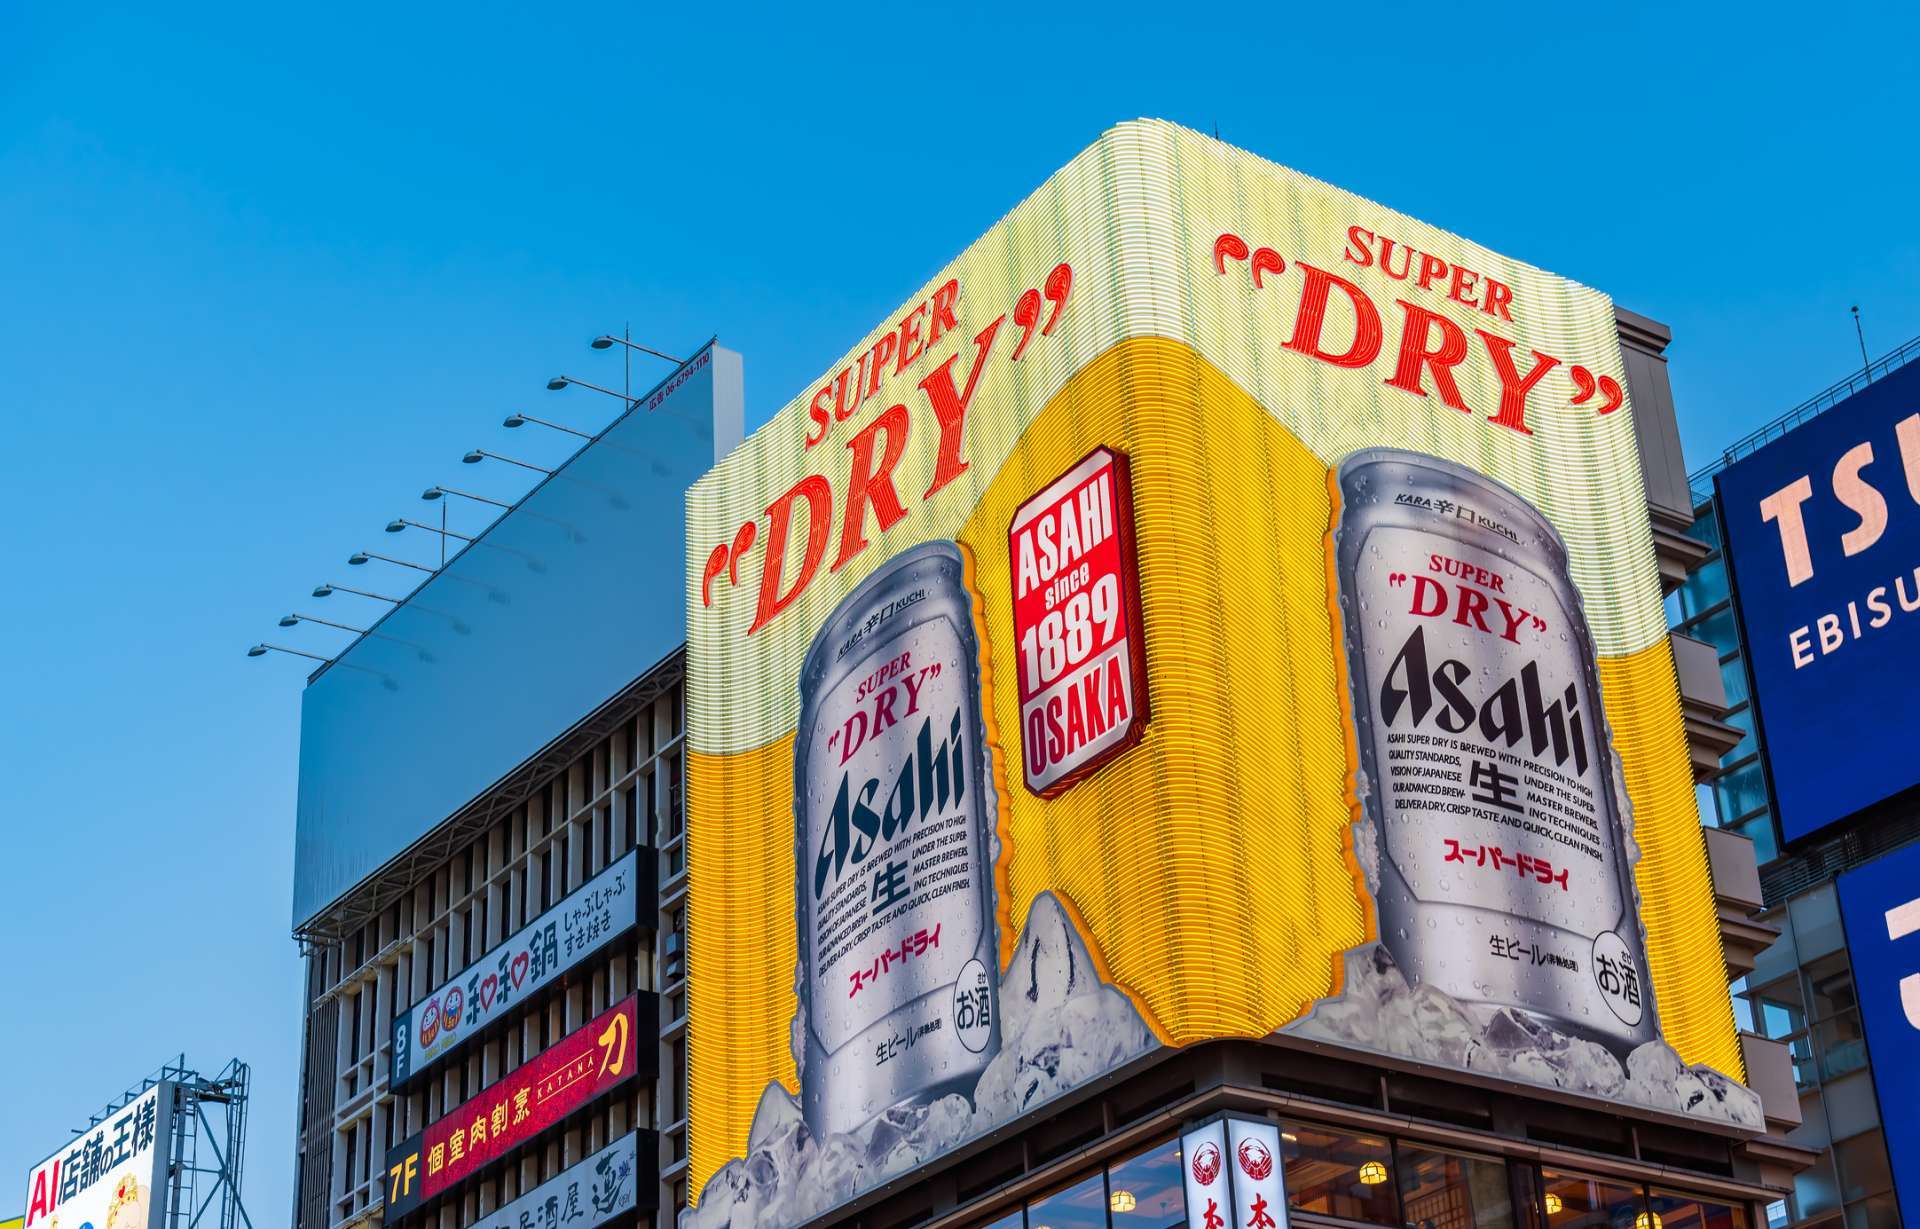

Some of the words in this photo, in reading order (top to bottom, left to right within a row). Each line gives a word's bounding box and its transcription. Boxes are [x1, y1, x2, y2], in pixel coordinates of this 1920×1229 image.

[1344, 224, 1516, 324] SUPER
[665, 351, 710, 397] 06-6794-1110
[805, 278, 961, 452] SUPER
[1017, 473, 1114, 601] ASAHI
[1395, 494, 1432, 508] KARA
[1434, 500, 1475, 524] 辛口
[1478, 516, 1518, 541] KUCHI
[1044, 562, 1091, 612] since
[1429, 554, 1505, 594] SUPER
[838, 628, 864, 658] KARA
[863, 602, 895, 634] 辛口
[895, 589, 926, 610] KUCHI
[1020, 572, 1120, 697] 1889
[1789, 566, 1920, 670] EBISU
[856, 650, 912, 704] SUPER
[1380, 624, 1589, 778] Asahi
[1028, 652, 1131, 778] OSAKA
[1387, 734, 1406, 744] ASAHI
[1407, 734, 1430, 745] SUPER
[1432, 736, 1448, 748] DRY
[1450, 740, 1458, 749] IS
[1460, 741, 1496, 759] BREWED
[1499, 752, 1521, 767] WITH
[1524, 760, 1565, 784] PRECISION
[1567, 776, 1577, 789] TO
[1577, 780, 1593, 799] HIGH
[1388, 751, 1416, 761] QUALITY
[1524, 775, 1555, 794] UNDER
[1556, 785, 1572, 800] THE
[1390, 766, 1412, 777] VISION
[1412, 767, 1422, 777] OF
[1421, 767, 1462, 782] JAPANESE
[1527, 792, 1563, 812] MASTER
[1469, 759, 1525, 814] 生
[815, 706, 965, 900] Asahi
[1392, 782, 1405, 793] OUR
[1405, 783, 1441, 795] ADVANCED
[1529, 808, 1547, 823] ING
[1548, 813, 1600, 845] TECHNIQUES
[1395, 799, 1422, 810] DELIVER
[1447, 803, 1471, 816] CRISP
[1472, 808, 1499, 823] TASTE
[1500, 815, 1522, 829] AND
[1554, 832, 1579, 850] CLEAN
[847, 871, 859, 886] DRY
[859, 866, 866, 876] IS
[866, 849, 893, 872] BREWED
[894, 838, 911, 856] WITH
[912, 822, 945, 843] PRECISION
[945, 817, 954, 828] TO
[953, 815, 967, 826] HIGH
[911, 841, 935, 860] UNDER
[936, 836, 948, 848] THE
[913, 876, 927, 892] ING
[927, 862, 969, 884] TECHNIQUES
[1444, 838, 1569, 891] スーパードライ
[564, 869, 627, 932] しゃぶしゃぶ
[840, 896, 867, 925] JAPANESE
[912, 855, 941, 876] MASTER
[853, 927, 869, 949] CRISP
[871, 915, 891, 935] TASTE
[891, 905, 908, 923] AND
[931, 885, 951, 900] CLEAN
[871, 860, 911, 916] 生
[564, 911, 611, 957] すき焼き
[849, 922, 942, 999] スーパードライ
[956, 985, 990, 1030] お酒
[1596, 953, 1641, 1009] お酒
[396, 1024, 406, 1079] 8F
[597, 1012, 629, 1081] 刀
[537, 1055, 594, 1100] KATANA
[428, 1086, 531, 1177] 個室肉割烹
[27, 1095, 156, 1229] AI店舗の王様
[390, 1152, 418, 1205] 7F
